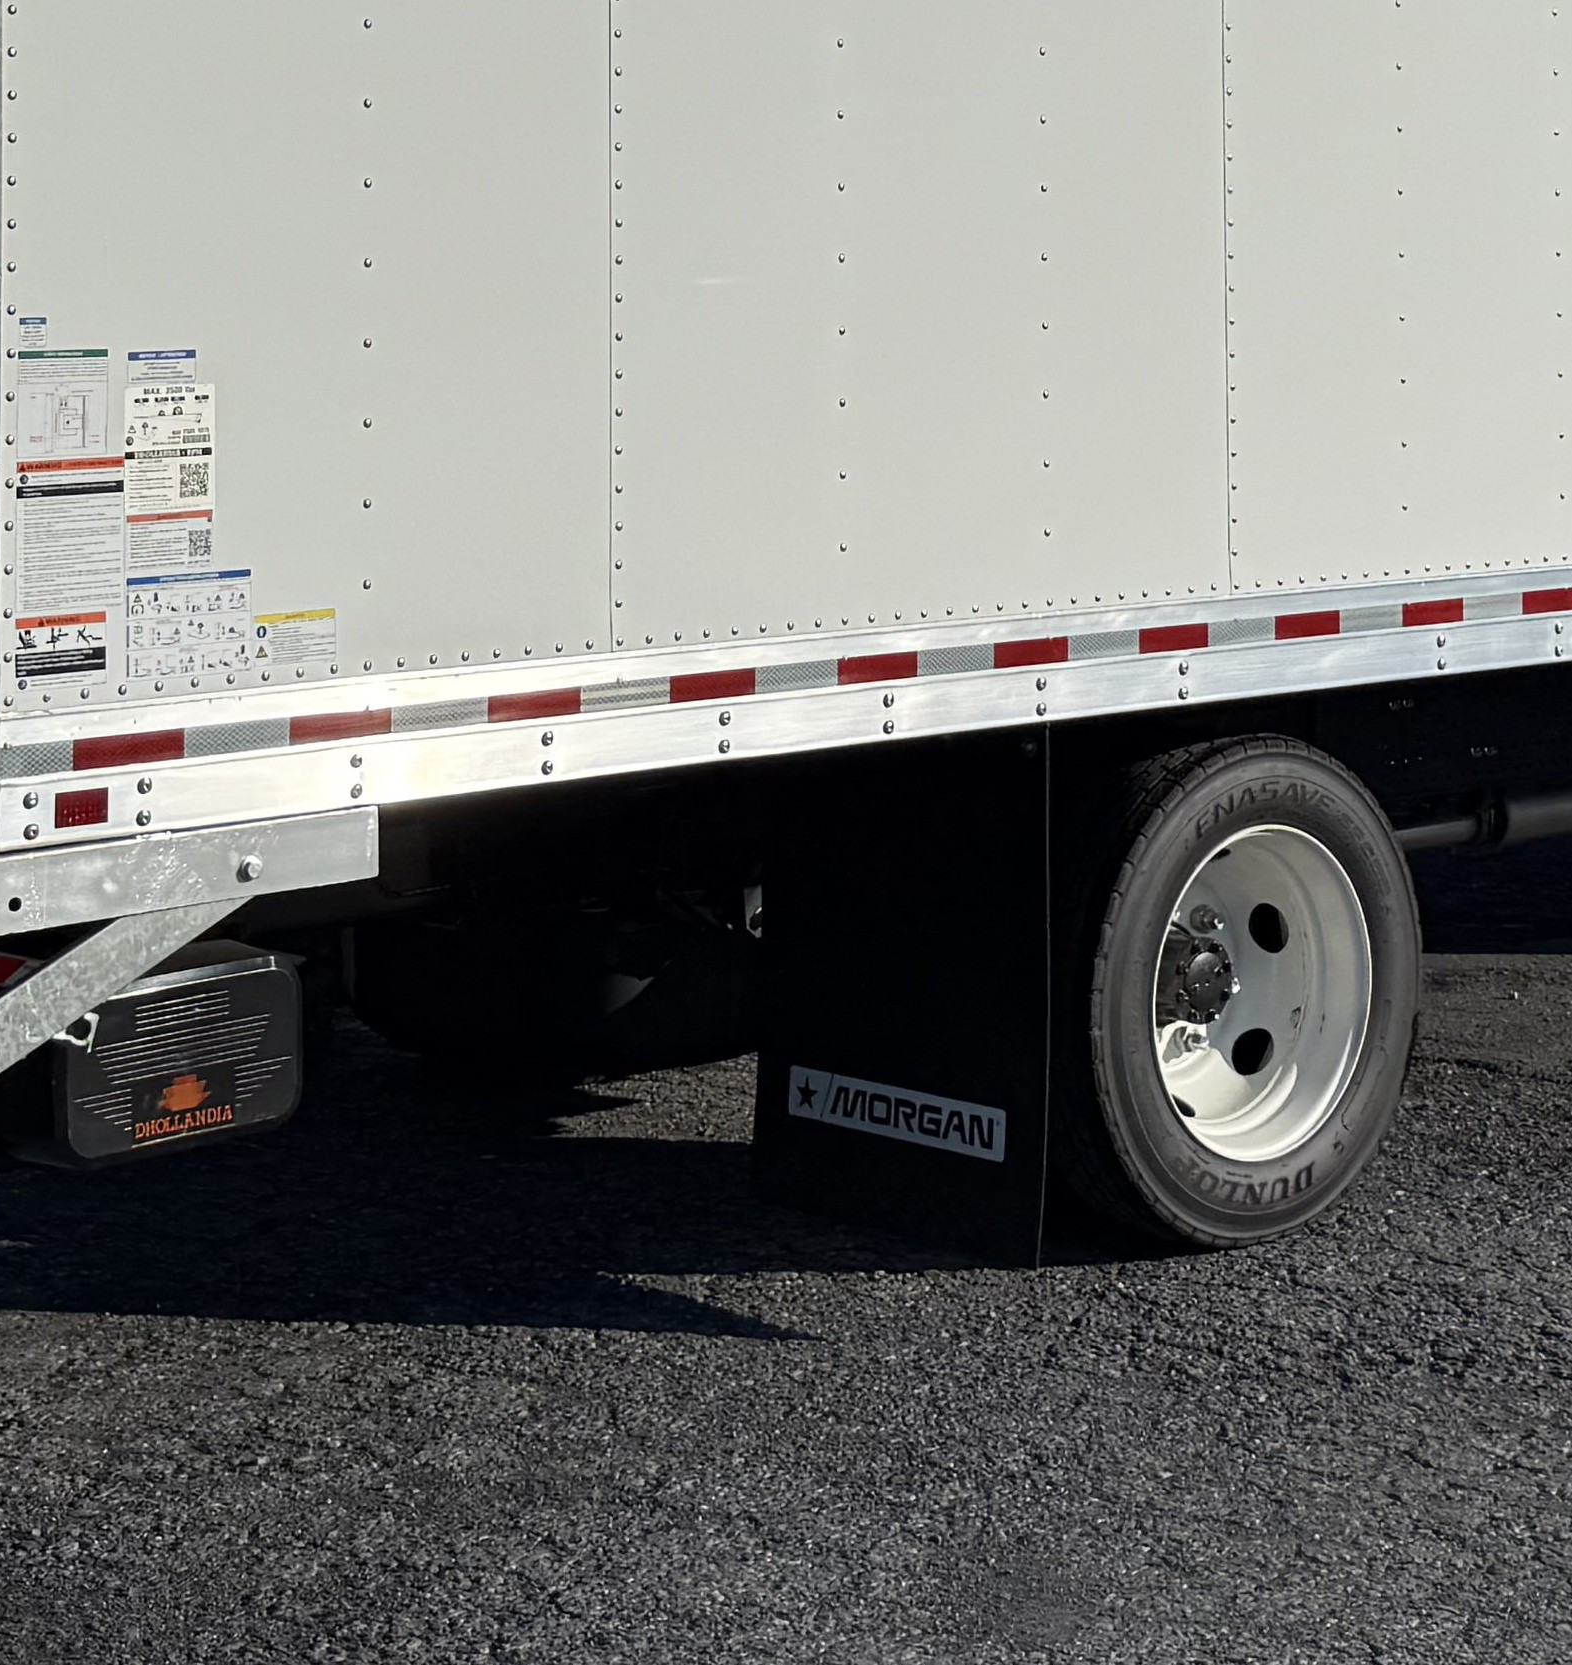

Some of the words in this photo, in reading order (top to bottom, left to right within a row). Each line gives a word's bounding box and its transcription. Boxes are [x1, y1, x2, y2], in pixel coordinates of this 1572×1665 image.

[1195, 781, 1336, 840] ENASAVE
[134, 1104, 233, 1139] DHOLLANDIA
[830, 1086, 994, 1150] MORGAN
[1172, 1157, 1315, 1205] DUNLOP
